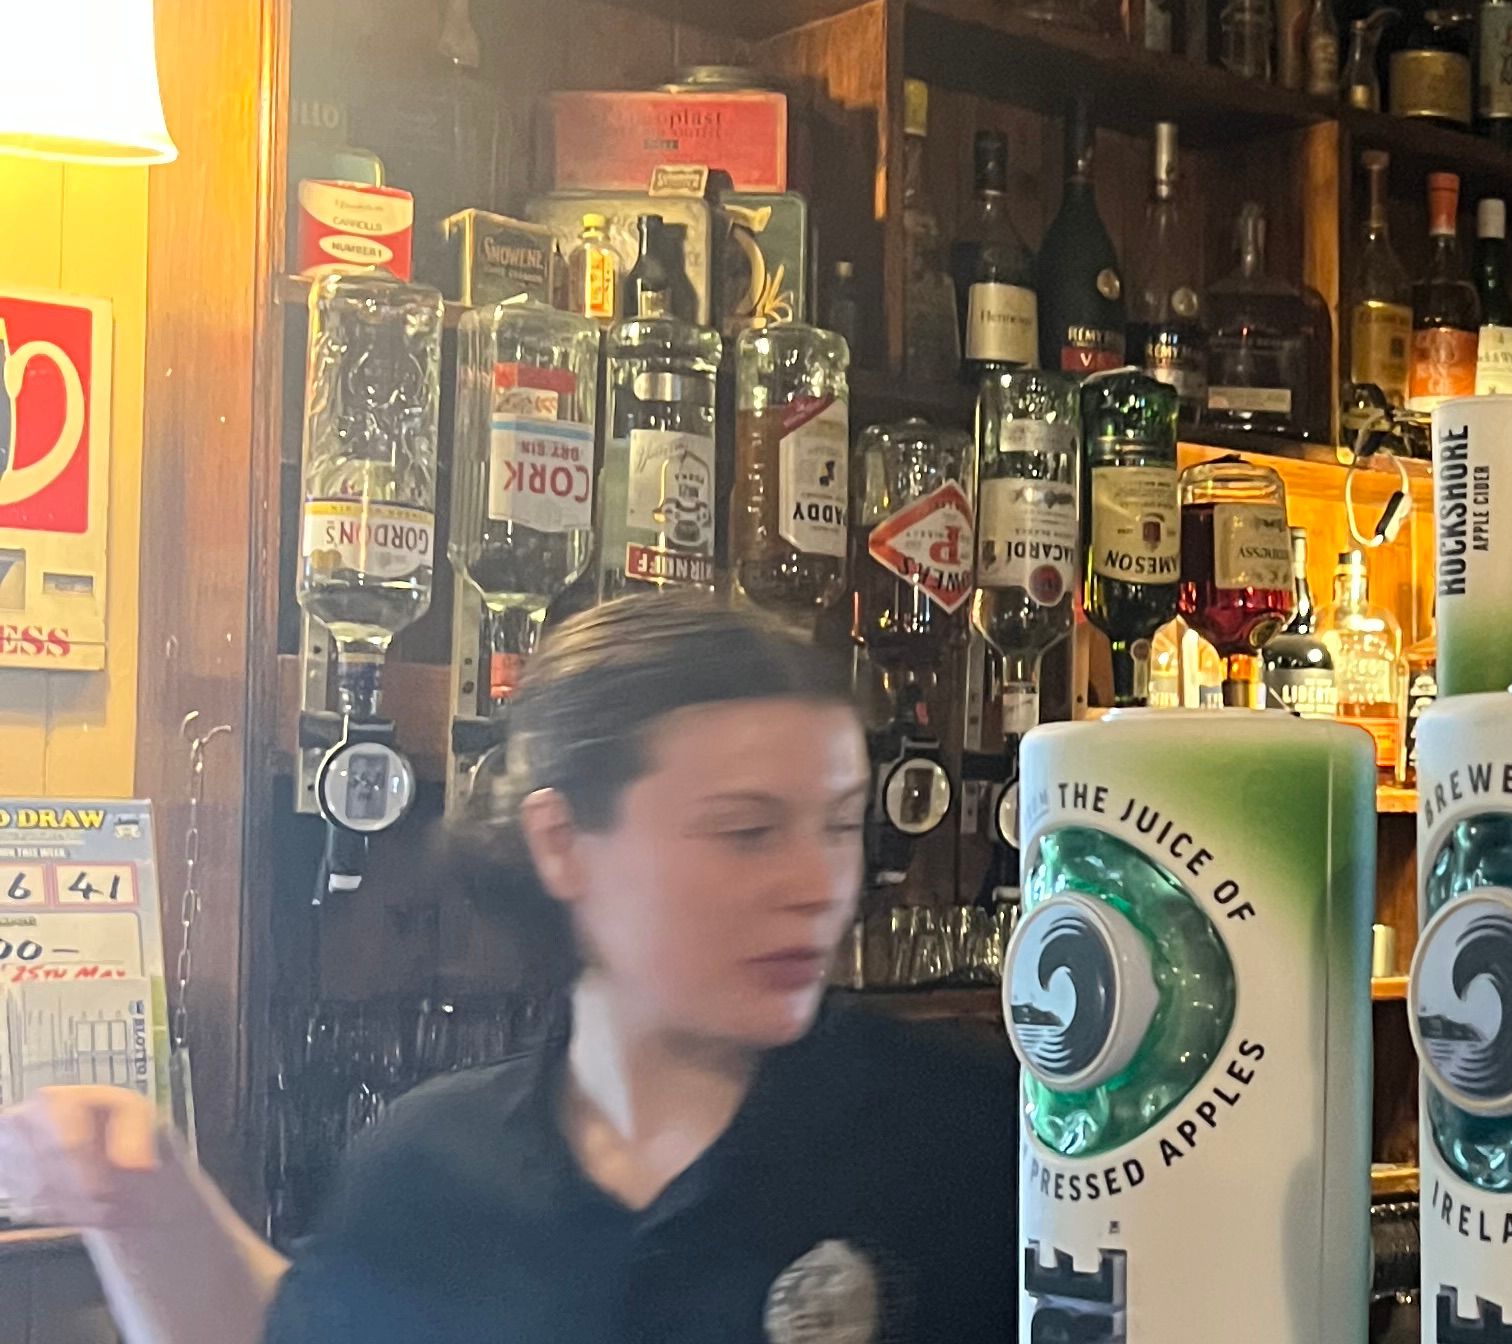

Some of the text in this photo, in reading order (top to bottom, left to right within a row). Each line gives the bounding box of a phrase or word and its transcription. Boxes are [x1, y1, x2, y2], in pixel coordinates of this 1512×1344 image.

[520, 439, 580, 461] DRY GIN
[503, 460, 589, 503] CORK
[1439, 424, 1468, 597] ROCKSHORE
[1473, 465, 1489, 551] APPLE CIDER
[326, 520, 429, 553] GORDON'S
[929, 526, 961, 565] P
[1105, 549, 1179, 574] AMESON
[17, 809, 105, 829] DRAW
[1058, 782, 1109, 814] THE
[1121, 798, 1214, 876] JUICE
[1213, 879, 1255, 925] OF
[69, 871, 121, 900] 41
[1030, 1038, 1267, 1203] PRESSED APPLES
